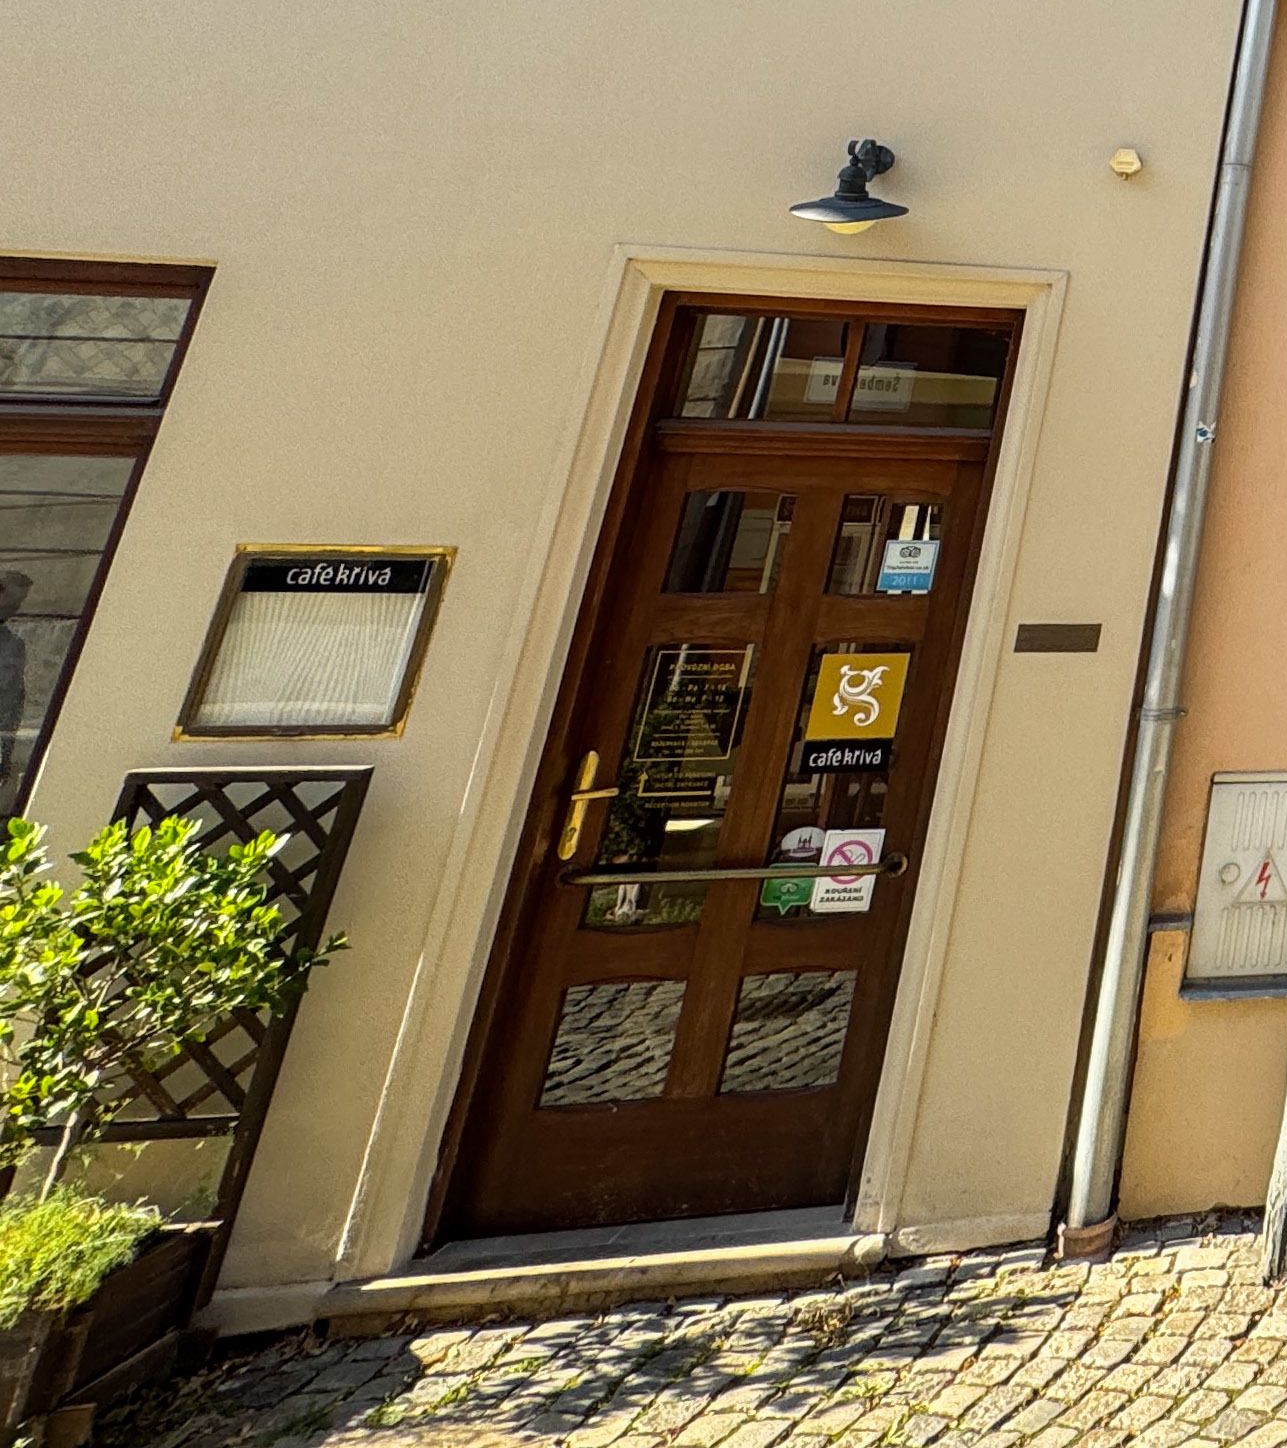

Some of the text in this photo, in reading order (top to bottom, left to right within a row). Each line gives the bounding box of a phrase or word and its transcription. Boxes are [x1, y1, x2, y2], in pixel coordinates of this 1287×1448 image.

[286, 562, 392, 586] café křivá
[809, 748, 882, 767] café křivá
